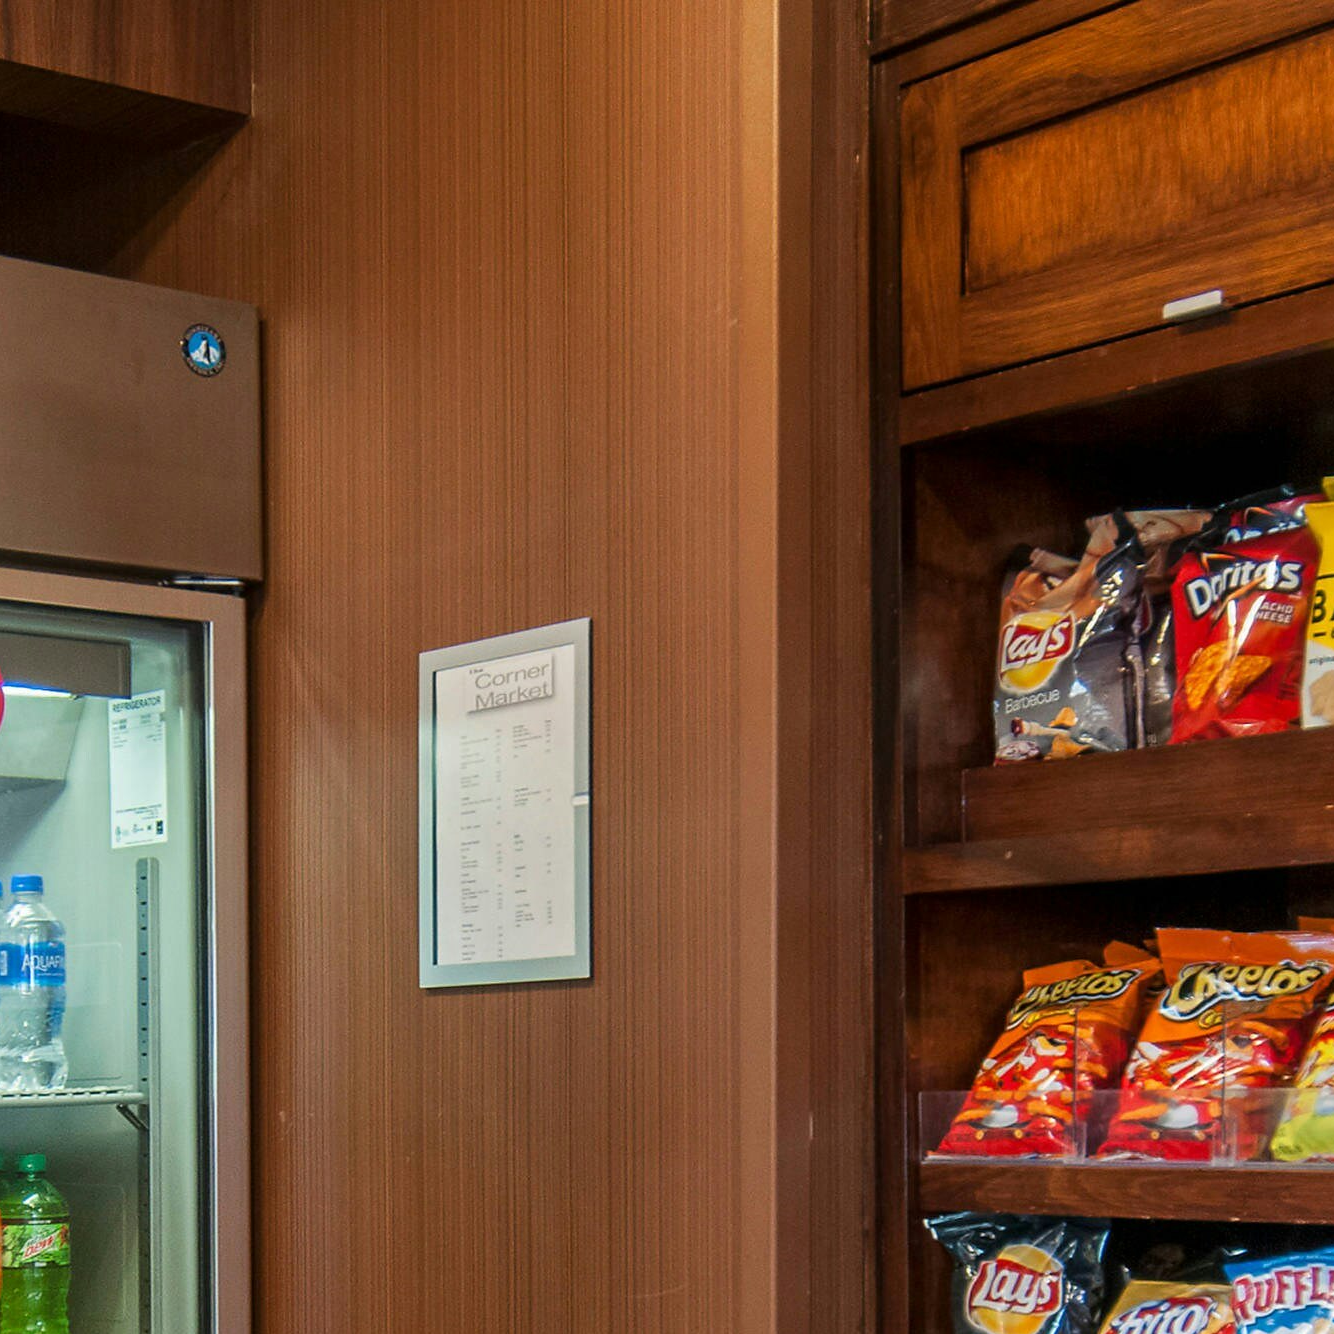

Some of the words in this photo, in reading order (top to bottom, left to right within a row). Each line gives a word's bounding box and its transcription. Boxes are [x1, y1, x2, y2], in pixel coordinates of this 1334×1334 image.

[1185, 560, 1303, 619] Doritos
[474, 662, 551, 690] Corner
[474, 682, 551, 711] Market
[1005, 689, 1061, 714] Barbecue
[1162, 963, 1324, 1019] Cheetos
[970, 1262, 1061, 1314] Lay's
